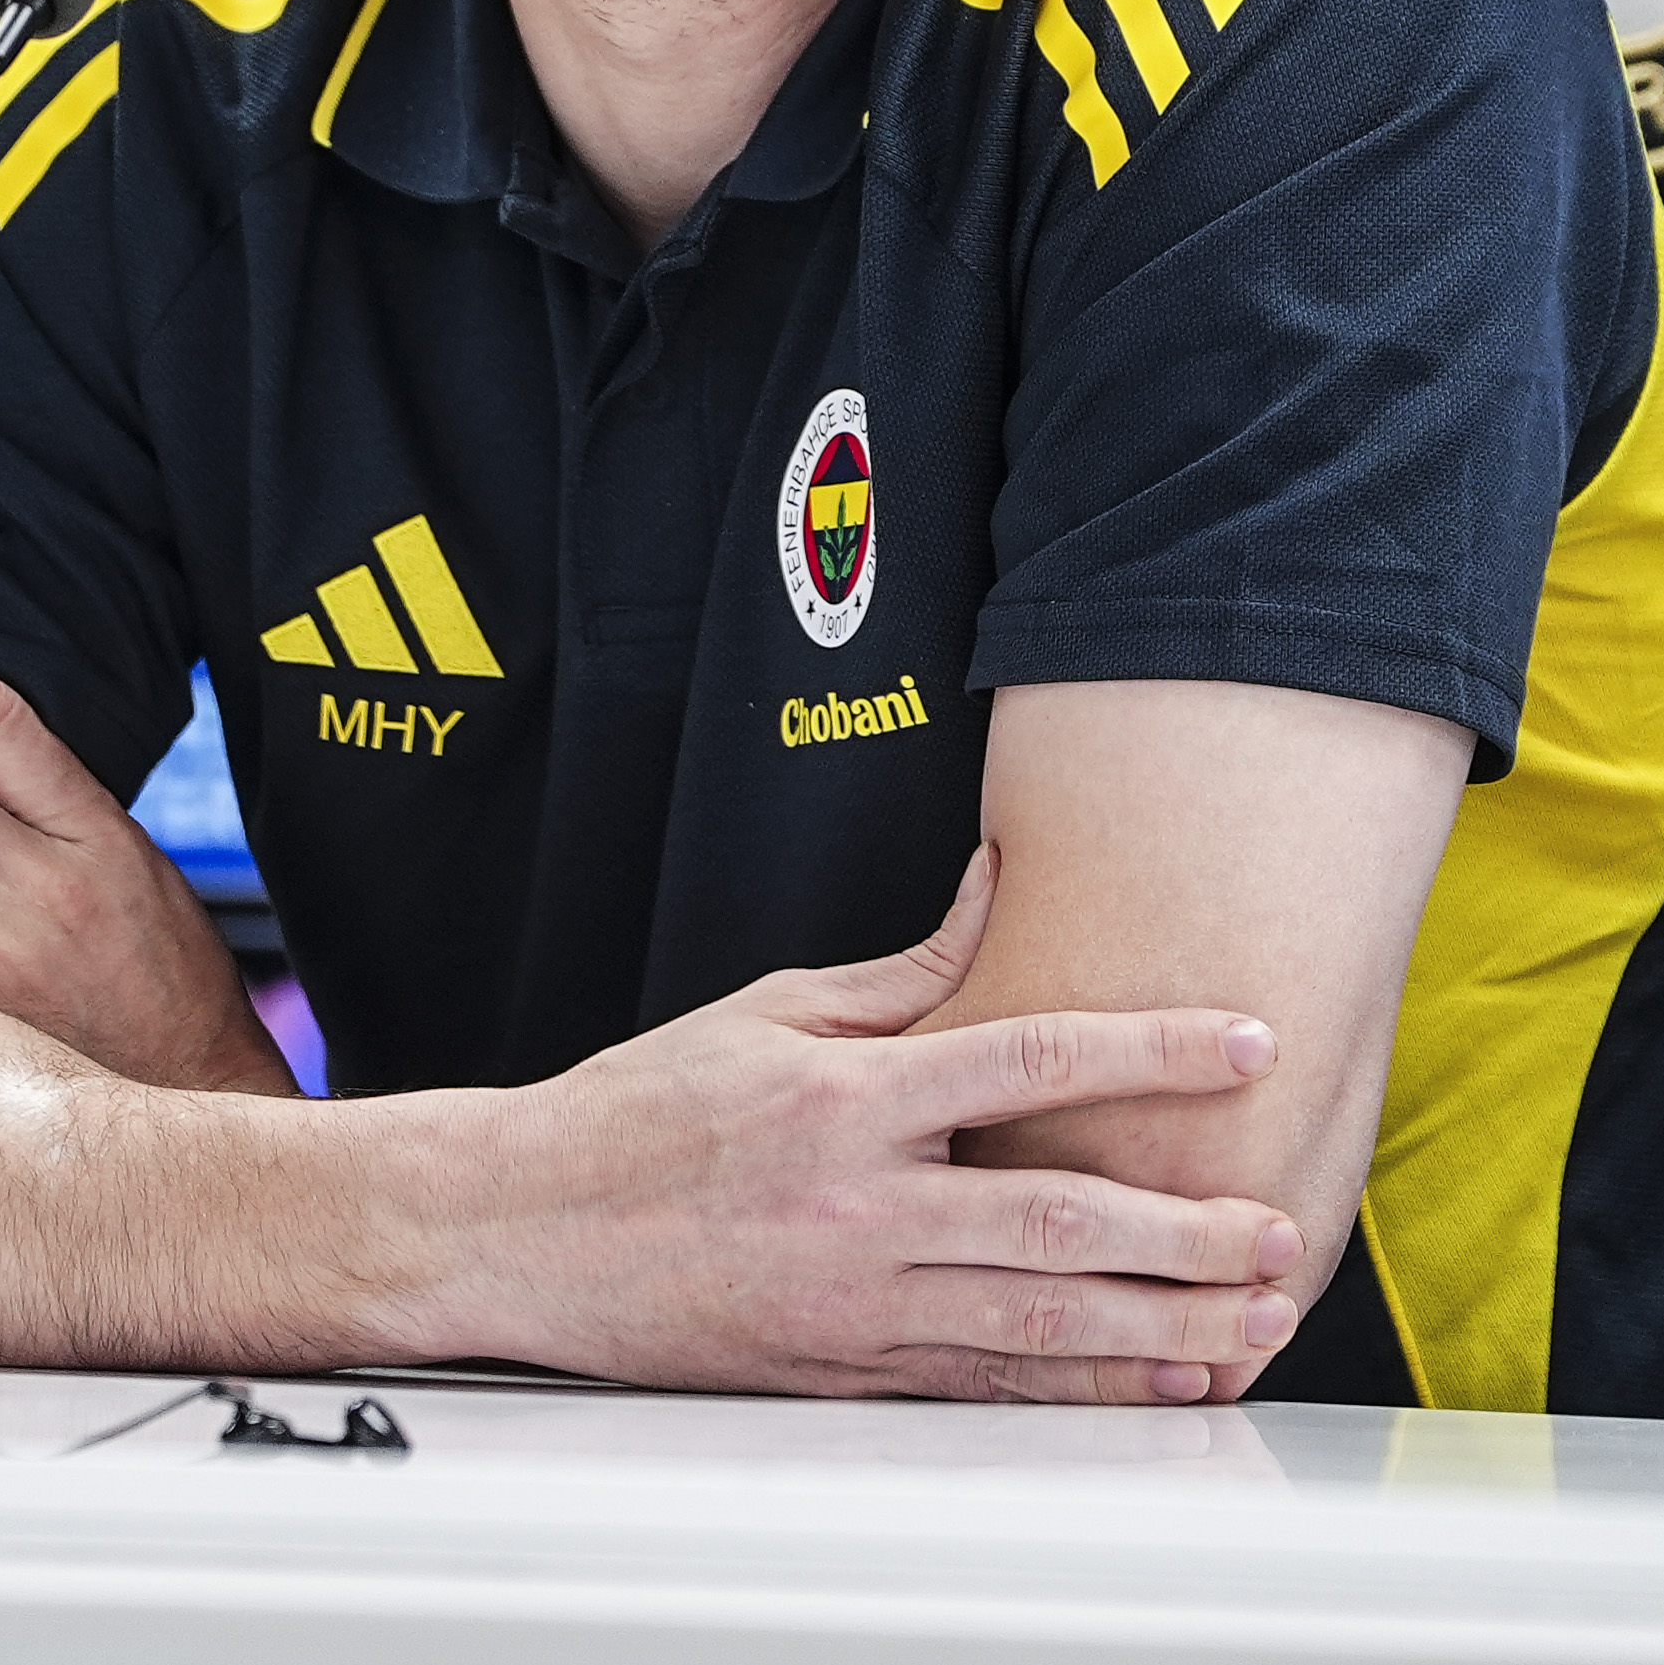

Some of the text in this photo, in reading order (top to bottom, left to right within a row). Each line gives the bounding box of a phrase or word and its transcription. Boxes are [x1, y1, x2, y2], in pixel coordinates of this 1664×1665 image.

[842, 398, 868, 433] SPO
[820, 610, 849, 639] 1907
[318, 693, 464, 758] MHY
[780, 675, 929, 747] Chobani
